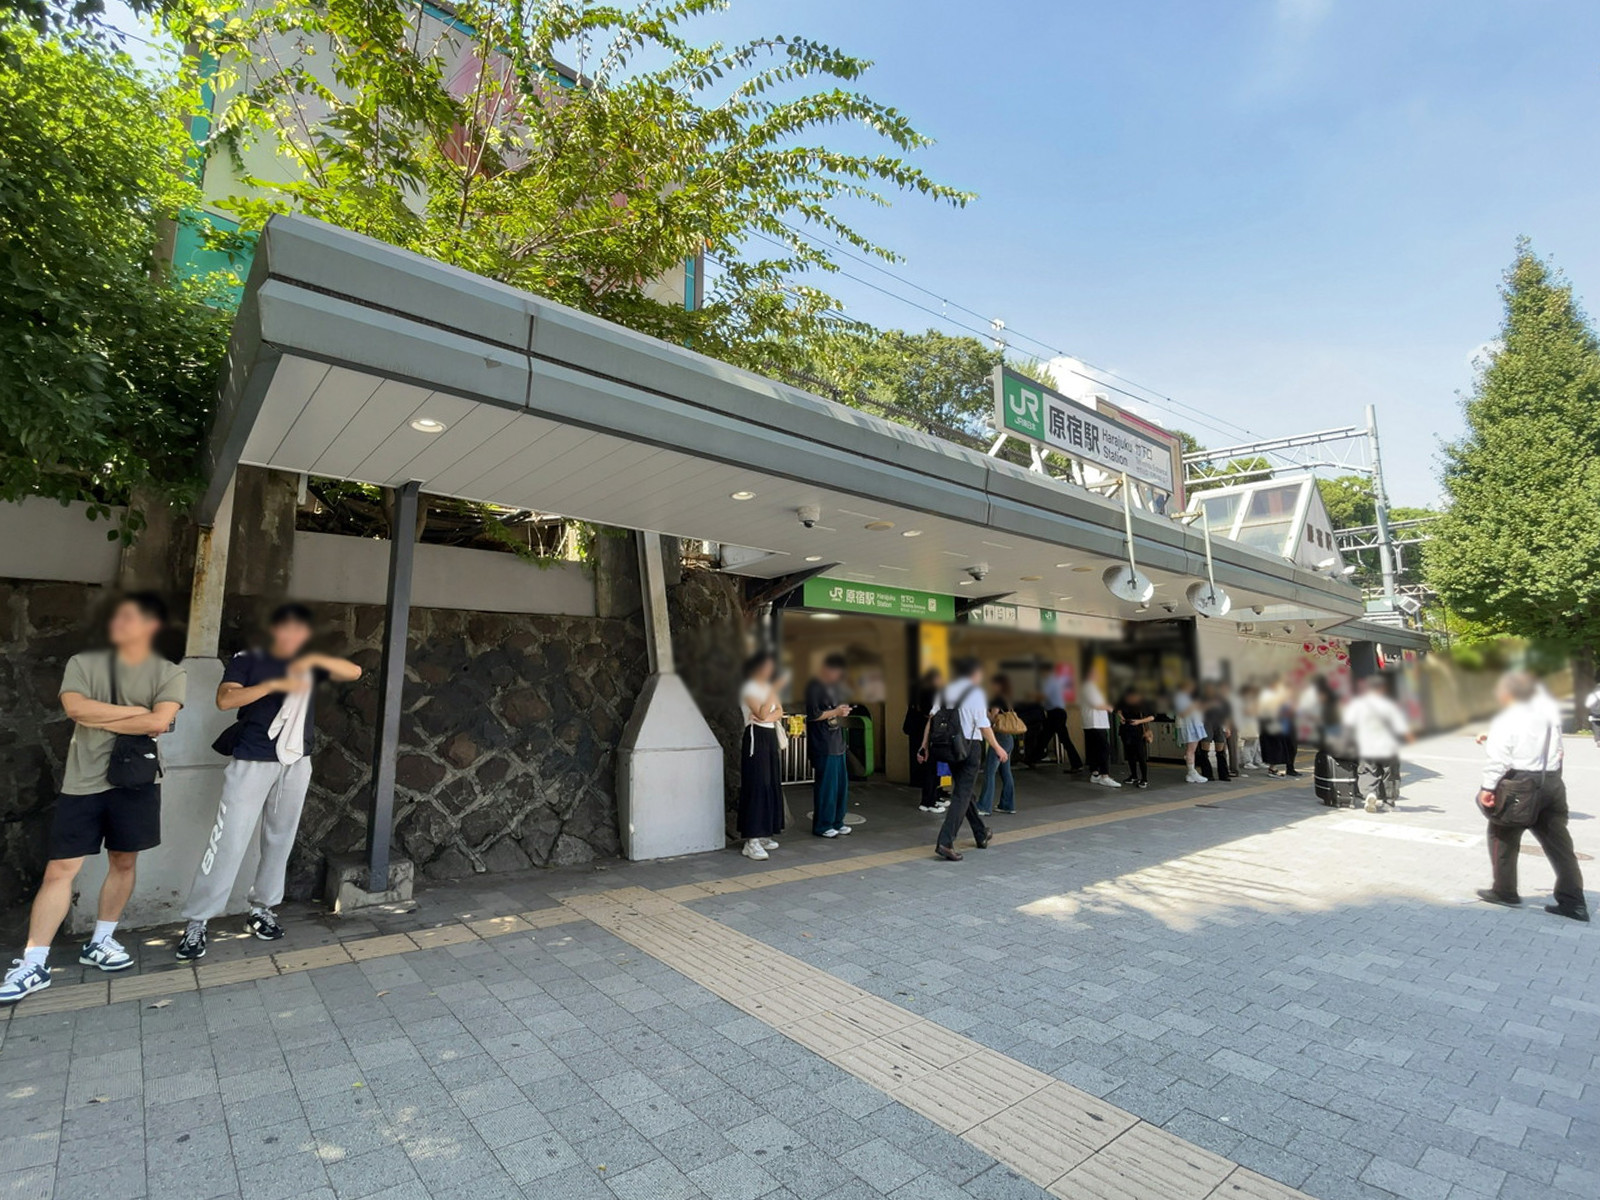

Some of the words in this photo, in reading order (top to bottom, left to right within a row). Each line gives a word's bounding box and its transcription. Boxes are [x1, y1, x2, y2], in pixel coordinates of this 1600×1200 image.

[1009, 387, 1040, 424] JR
[1049, 405, 1100, 455] 原宿駅
[1103, 429, 1133, 453] Harajuku
[1103, 446, 1128, 466] Station
[829, 587, 843, 598] JR
[846, 589, 875, 606] 原宿駅
